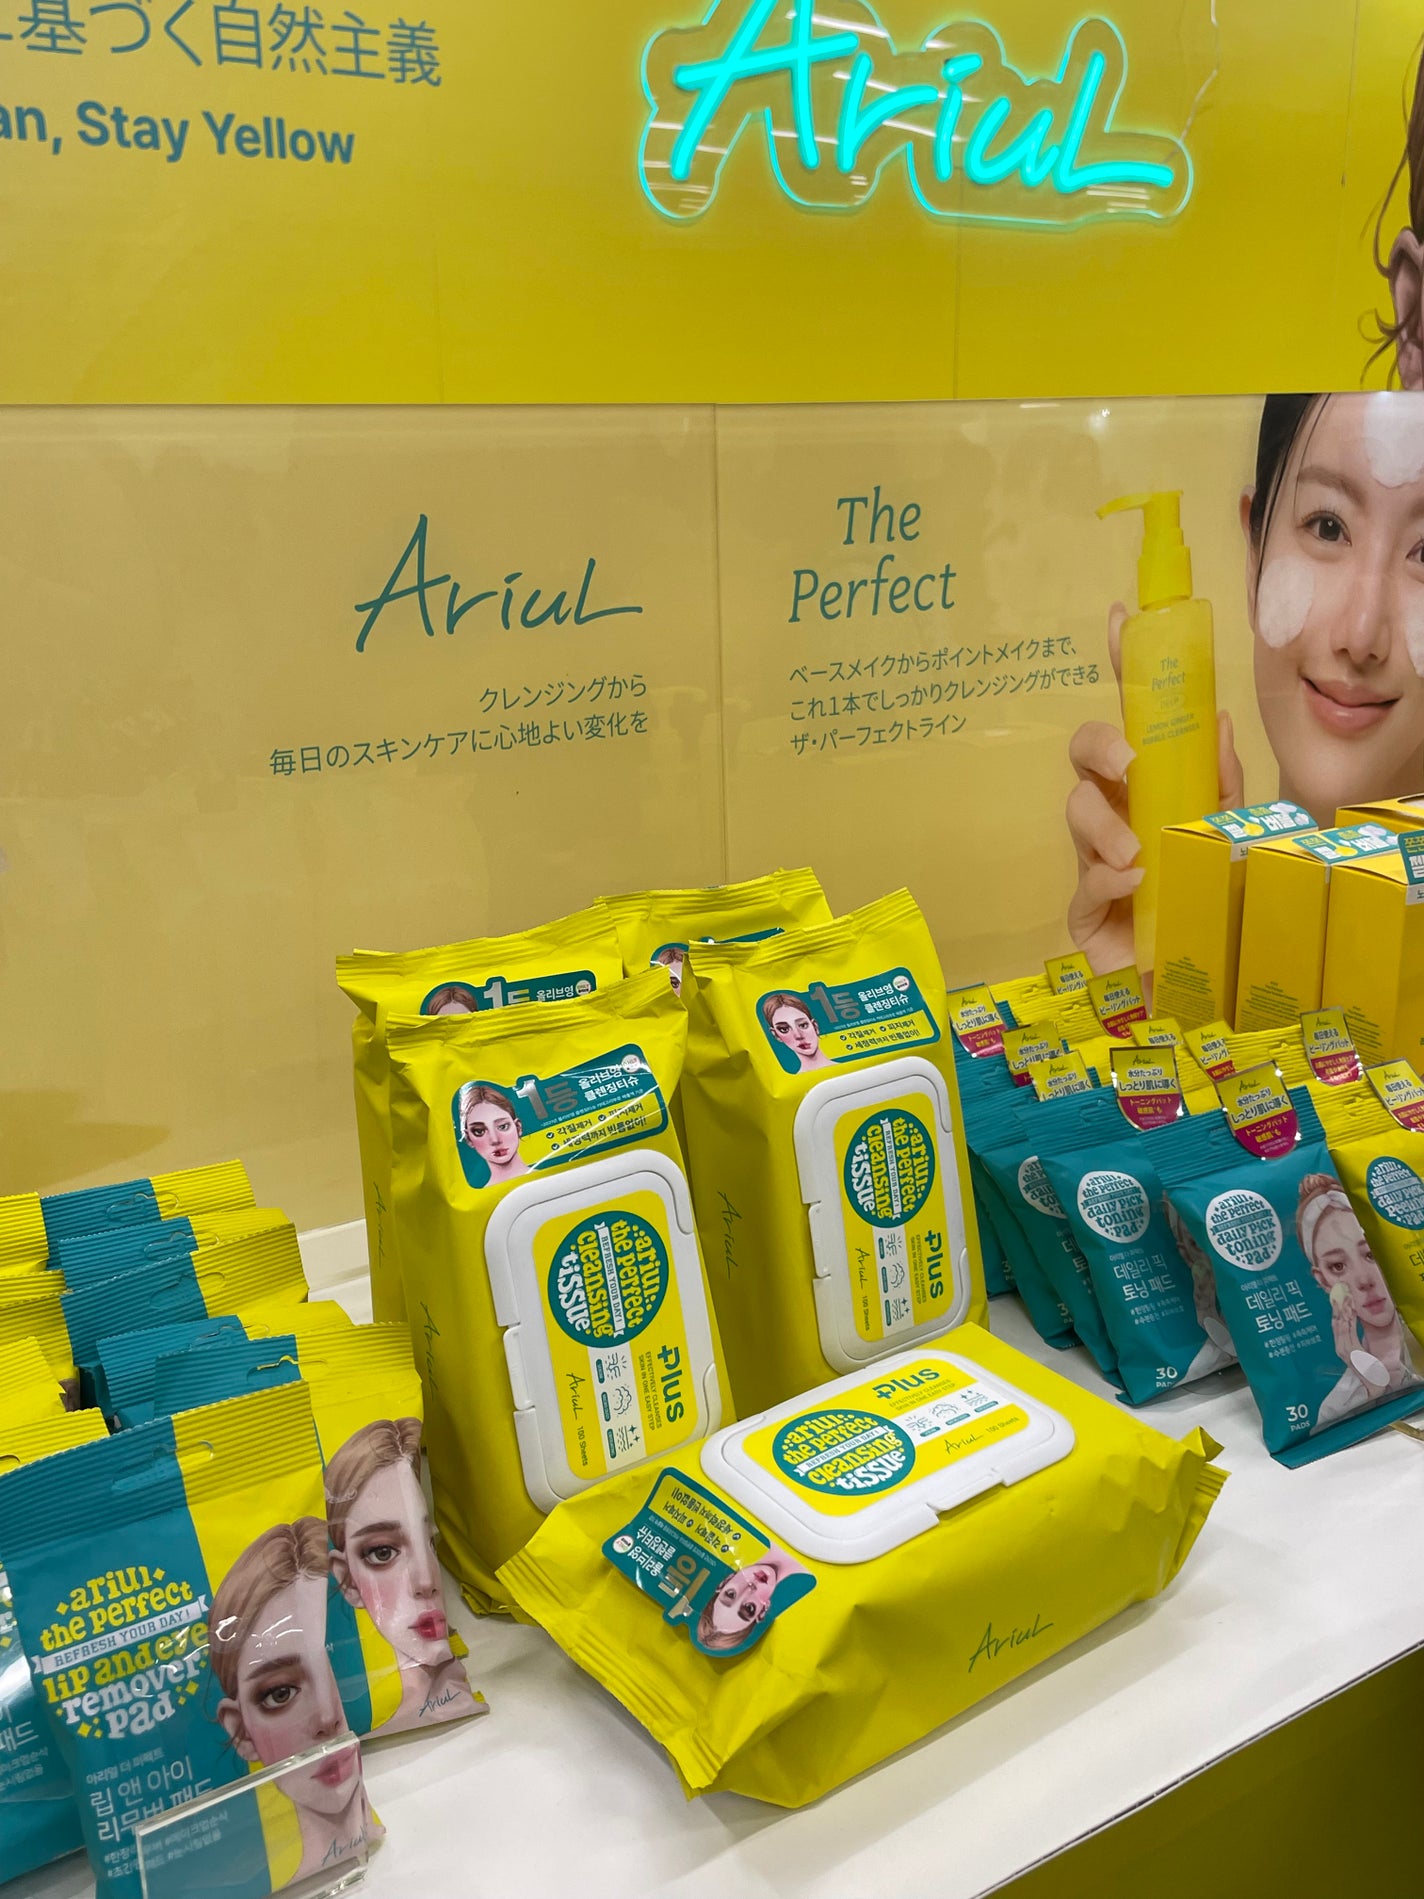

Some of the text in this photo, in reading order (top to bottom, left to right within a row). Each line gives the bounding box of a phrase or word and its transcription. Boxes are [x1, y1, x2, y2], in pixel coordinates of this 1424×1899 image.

[0, 0, 441, 87] 基づく自然主義
[77, 101, 189, 162] Stay
[202, 111, 355, 164] Yellow
[836, 486, 921, 545] The
[788, 554, 957, 623] Perfect
[789, 635, 1077, 683] ベースメイクからポイントメイクまで、
[479, 674, 647, 714] クレンジングから
[790, 664, 1100, 721] これ1本でしっかりクレンジングができる
[268, 711, 649, 777] 毎日のスキンケアに心地よい変化を
[790, 714, 967, 755] ザ・パーフェクトライン
[536, 984, 575, 1001] 올리브영
[810, 986, 861, 1024] 1등
[858, 983, 894, 1002] 올리브영
[864, 993, 910, 1014] 클렌징티슈
[1103, 988, 1131, 1003] 毎日使える
[848, 1019, 915, 1039] 각질제거 피지제거
[955, 1013, 1000, 1031] しっとり肌に導く
[578, 1065, 623, 1089] 올리브영
[584, 1076, 640, 1102] 클렌징티슈
[1047, 1071, 1077, 1087] 水分たっぷり
[1119, 1079, 1176, 1092] しっとり肌に導く
[1128, 1068, 1162, 1078] 水分たっぷり
[514, 1078, 579, 1121] 1등
[1230, 1097, 1289, 1124] しっとり肌に導く
[1237, 1088, 1272, 1106] 水分たっぷり
[557, 1119, 593, 1136] 각질제거
[851, 1142, 876, 1213] tissue
[866, 1124, 893, 1219] cleansing
[892, 1117, 917, 1213] the perfect
[1083, 1185, 1098, 1198] the
[1100, 1178, 1133, 1194] perfect
[1087, 1202, 1117, 1218] daily
[1096, 1208, 1144, 1228] toning
[1210, 1208, 1229, 1224] the
[1230, 1200, 1265, 1219] perfect
[1115, 1223, 1138, 1238] pad
[1216, 1227, 1249, 1247] daily
[1249, 1219, 1276, 1238] pick
[1225, 1233, 1277, 1257] toning
[601, 1235, 615, 1276] REFRESH
[608, 1277, 618, 1301] YOUR
[635, 1235, 661, 1298] ariul
[1113, 1256, 1152, 1280] 데일리
[1153, 1253, 1168, 1271] 픽
[1244, 1247, 1272, 1266] pad
[577, 1230, 614, 1338] cleansing
[611, 1219, 644, 1328] the perfect
[1123, 1274, 1176, 1301] 토닝 패드
[557, 1250, 591, 1333] tissue
[1245, 1285, 1288, 1312] 데일리
[1288, 1279, 1303, 1299] 픽
[1255, 1301, 1313, 1335] 토닝 패드
[1156, 1366, 1178, 1380] 30
[646, 1351, 663, 1429] EFFECTIVELY CLEANSES
[985, 1416, 1020, 1435] 100 Sheets
[1286, 1403, 1309, 1423] 30
[1290, 1420, 1311, 1432] PADS
[576, 1426, 585, 1441] 100
[783, 1417, 878, 1466] the perfect
[580, 1441, 589, 1467] Sheets
[806, 1449, 839, 1468] REFRESH
[839, 1440, 861, 1455] YOUR
[808, 1431, 904, 1486] cleansing
[836, 1450, 906, 1491] tissue
[663, 1501, 688, 1524] 피지제거
[636, 1525, 676, 1562] 클렌징티슈
[695, 1523, 722, 1549] 각질제거
[628, 1545, 664, 1578] 올리브영
[69, 1566, 153, 1612] ariul
[658, 1555, 711, 1619] 1등
[40, 1581, 194, 1652] the perfect
[54, 1637, 118, 1668] REFRESH
[119, 1621, 157, 1646] YOUR
[42, 1622, 209, 1704] lip and eye
[61, 1653, 202, 1725] remover
[105, 1690, 176, 1739] pad
[89, 1755, 193, 1818] 립 앤 아이
